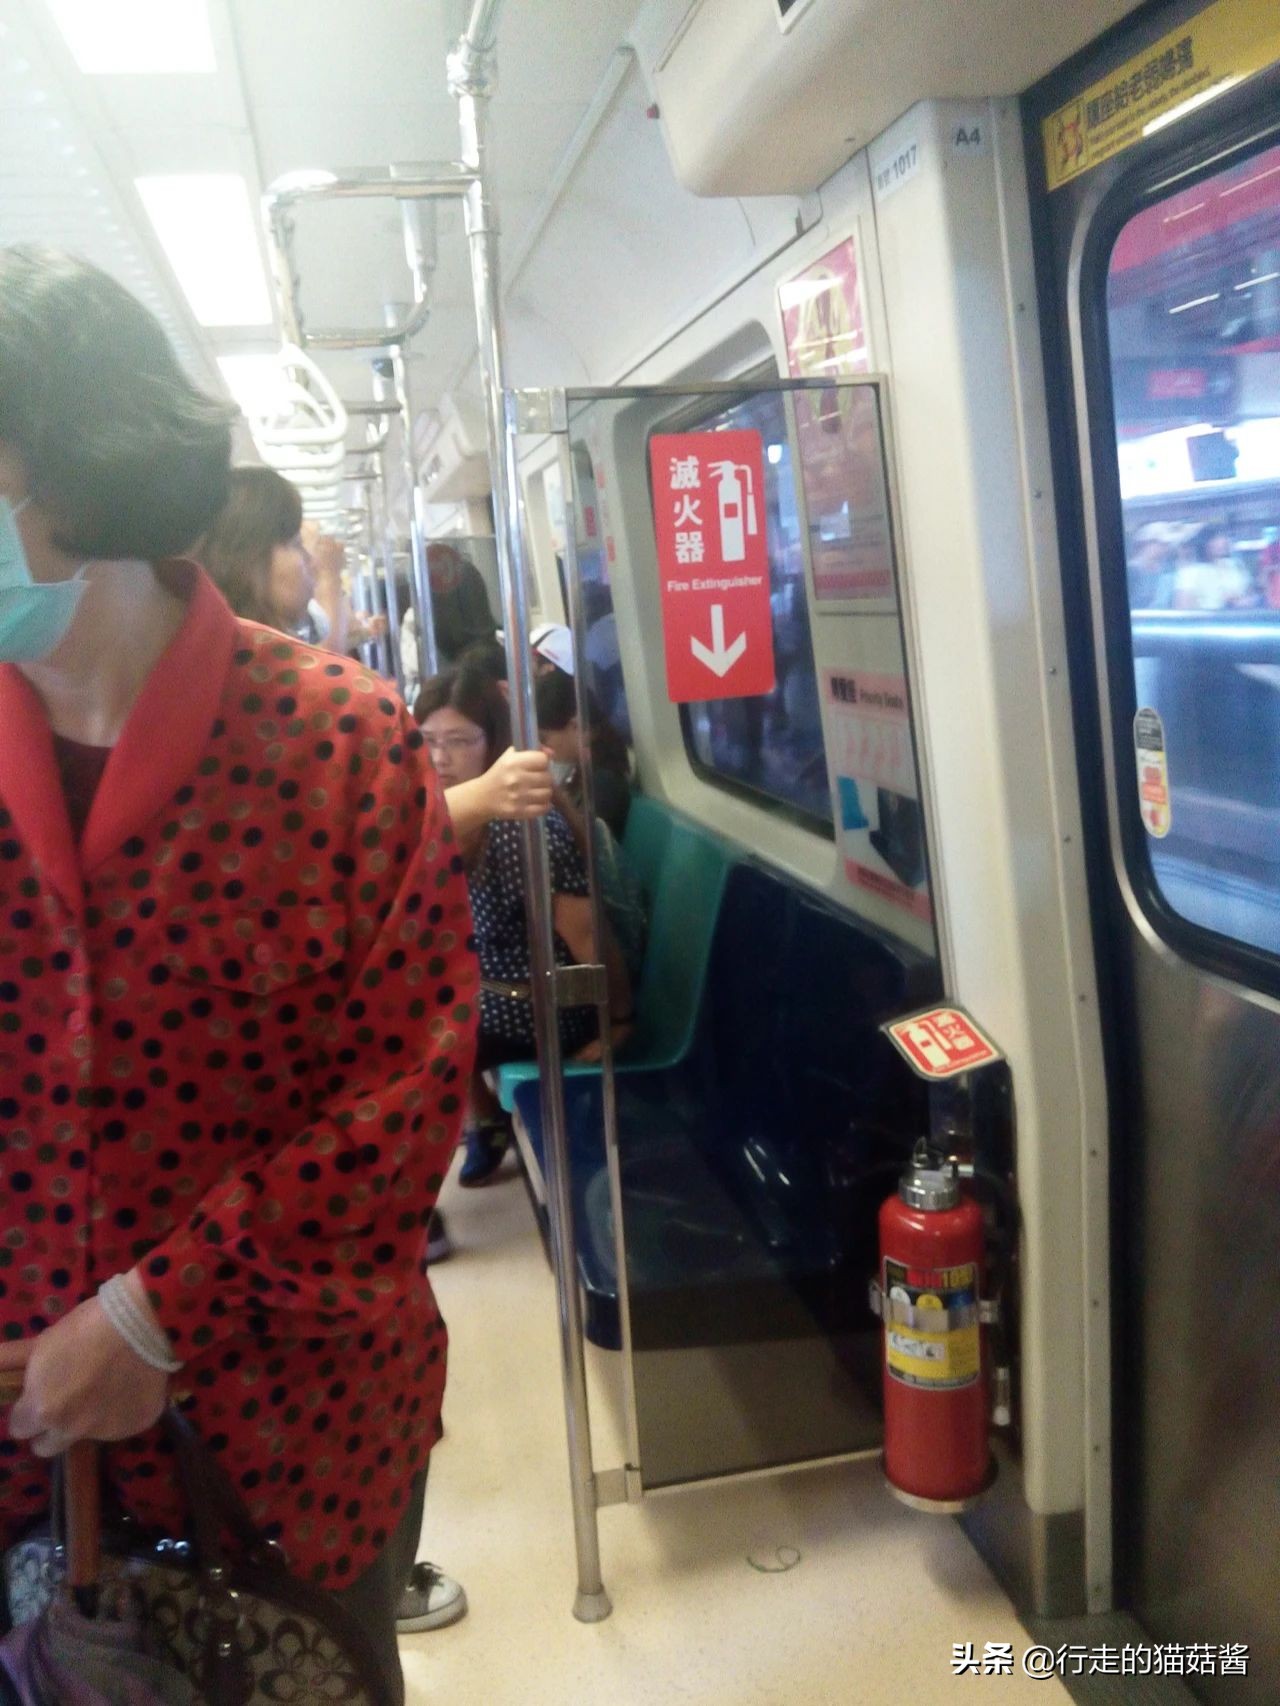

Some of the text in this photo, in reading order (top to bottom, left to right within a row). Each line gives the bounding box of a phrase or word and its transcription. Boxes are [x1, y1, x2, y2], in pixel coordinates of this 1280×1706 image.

[955, 127, 981, 146] A4
[893, 144, 917, 179] 1017
[669, 455, 704, 564] 滅火器
[667, 576, 763, 592] Fire Extinguisher
